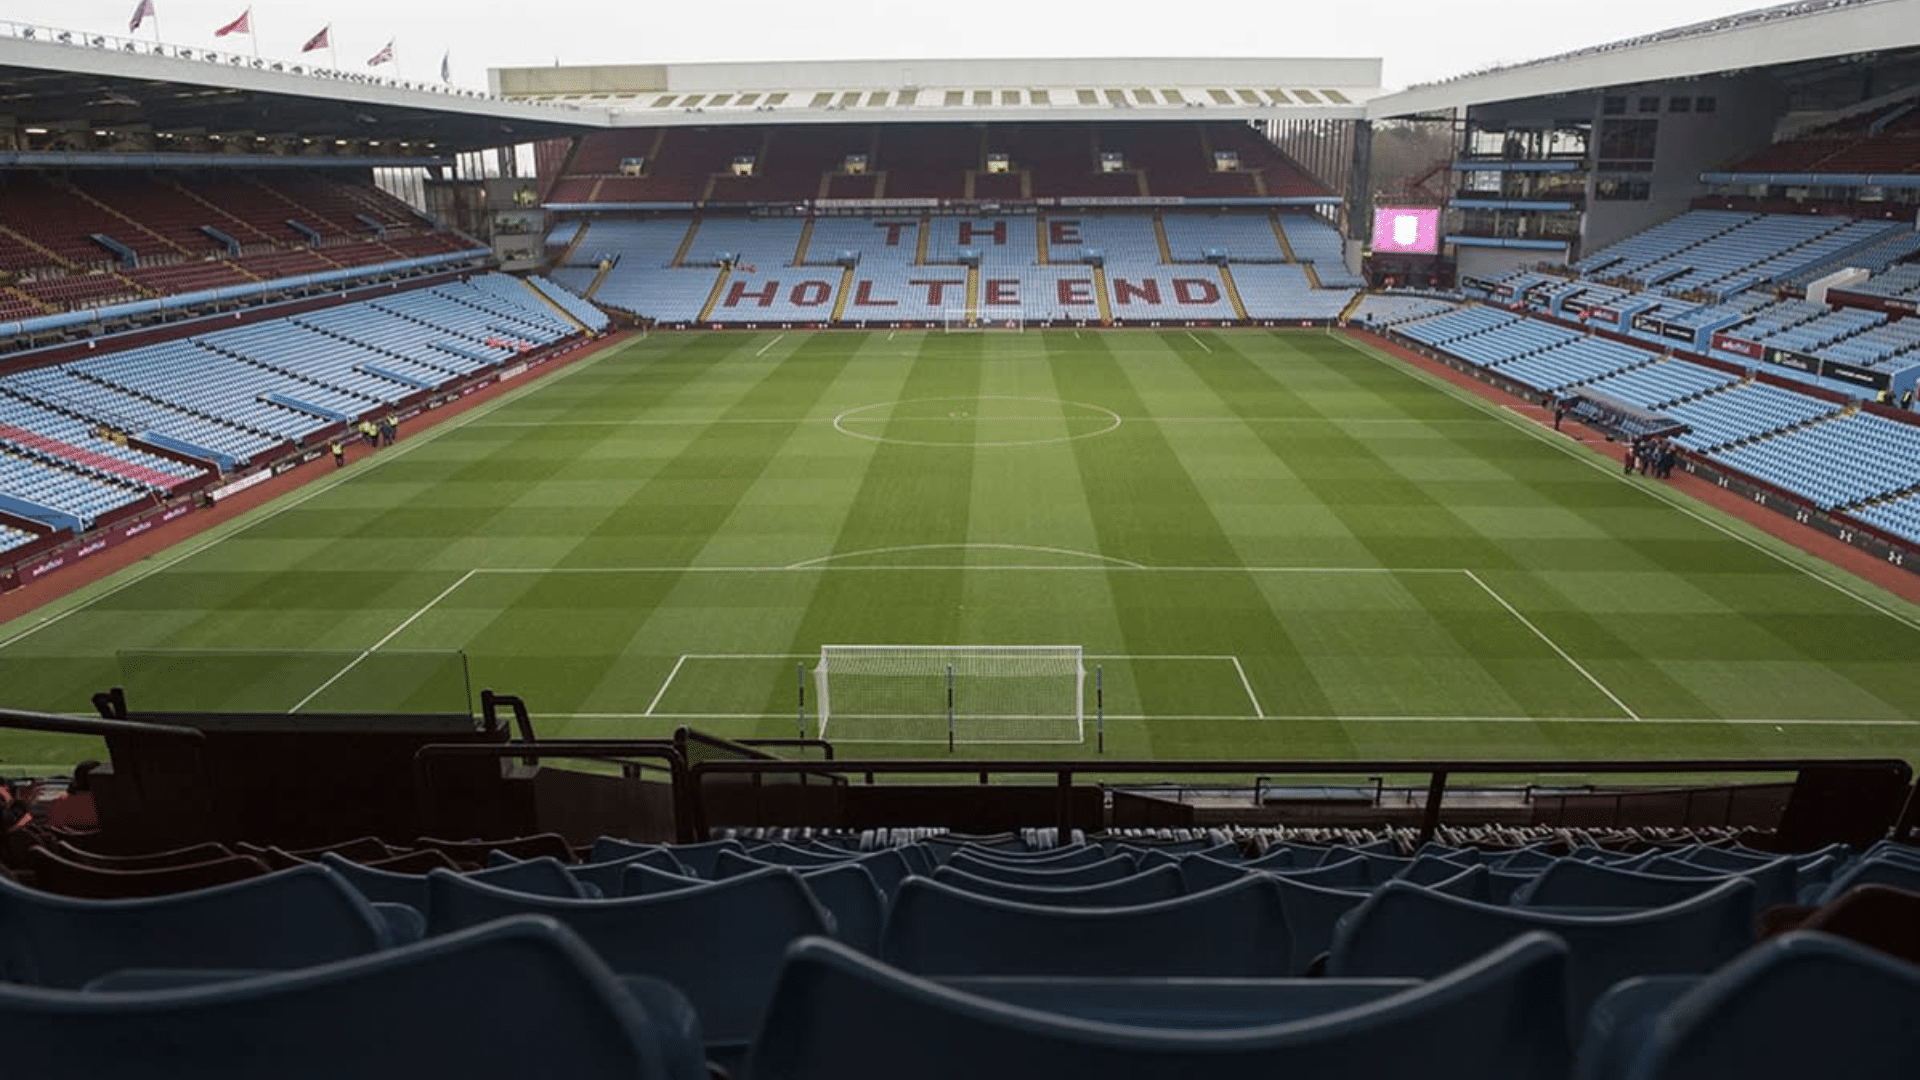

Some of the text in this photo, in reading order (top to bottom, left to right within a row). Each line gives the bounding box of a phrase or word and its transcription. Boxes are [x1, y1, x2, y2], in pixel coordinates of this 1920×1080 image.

[874, 221, 1083, 246] THE
[723, 278, 1221, 307] HOLTE END
